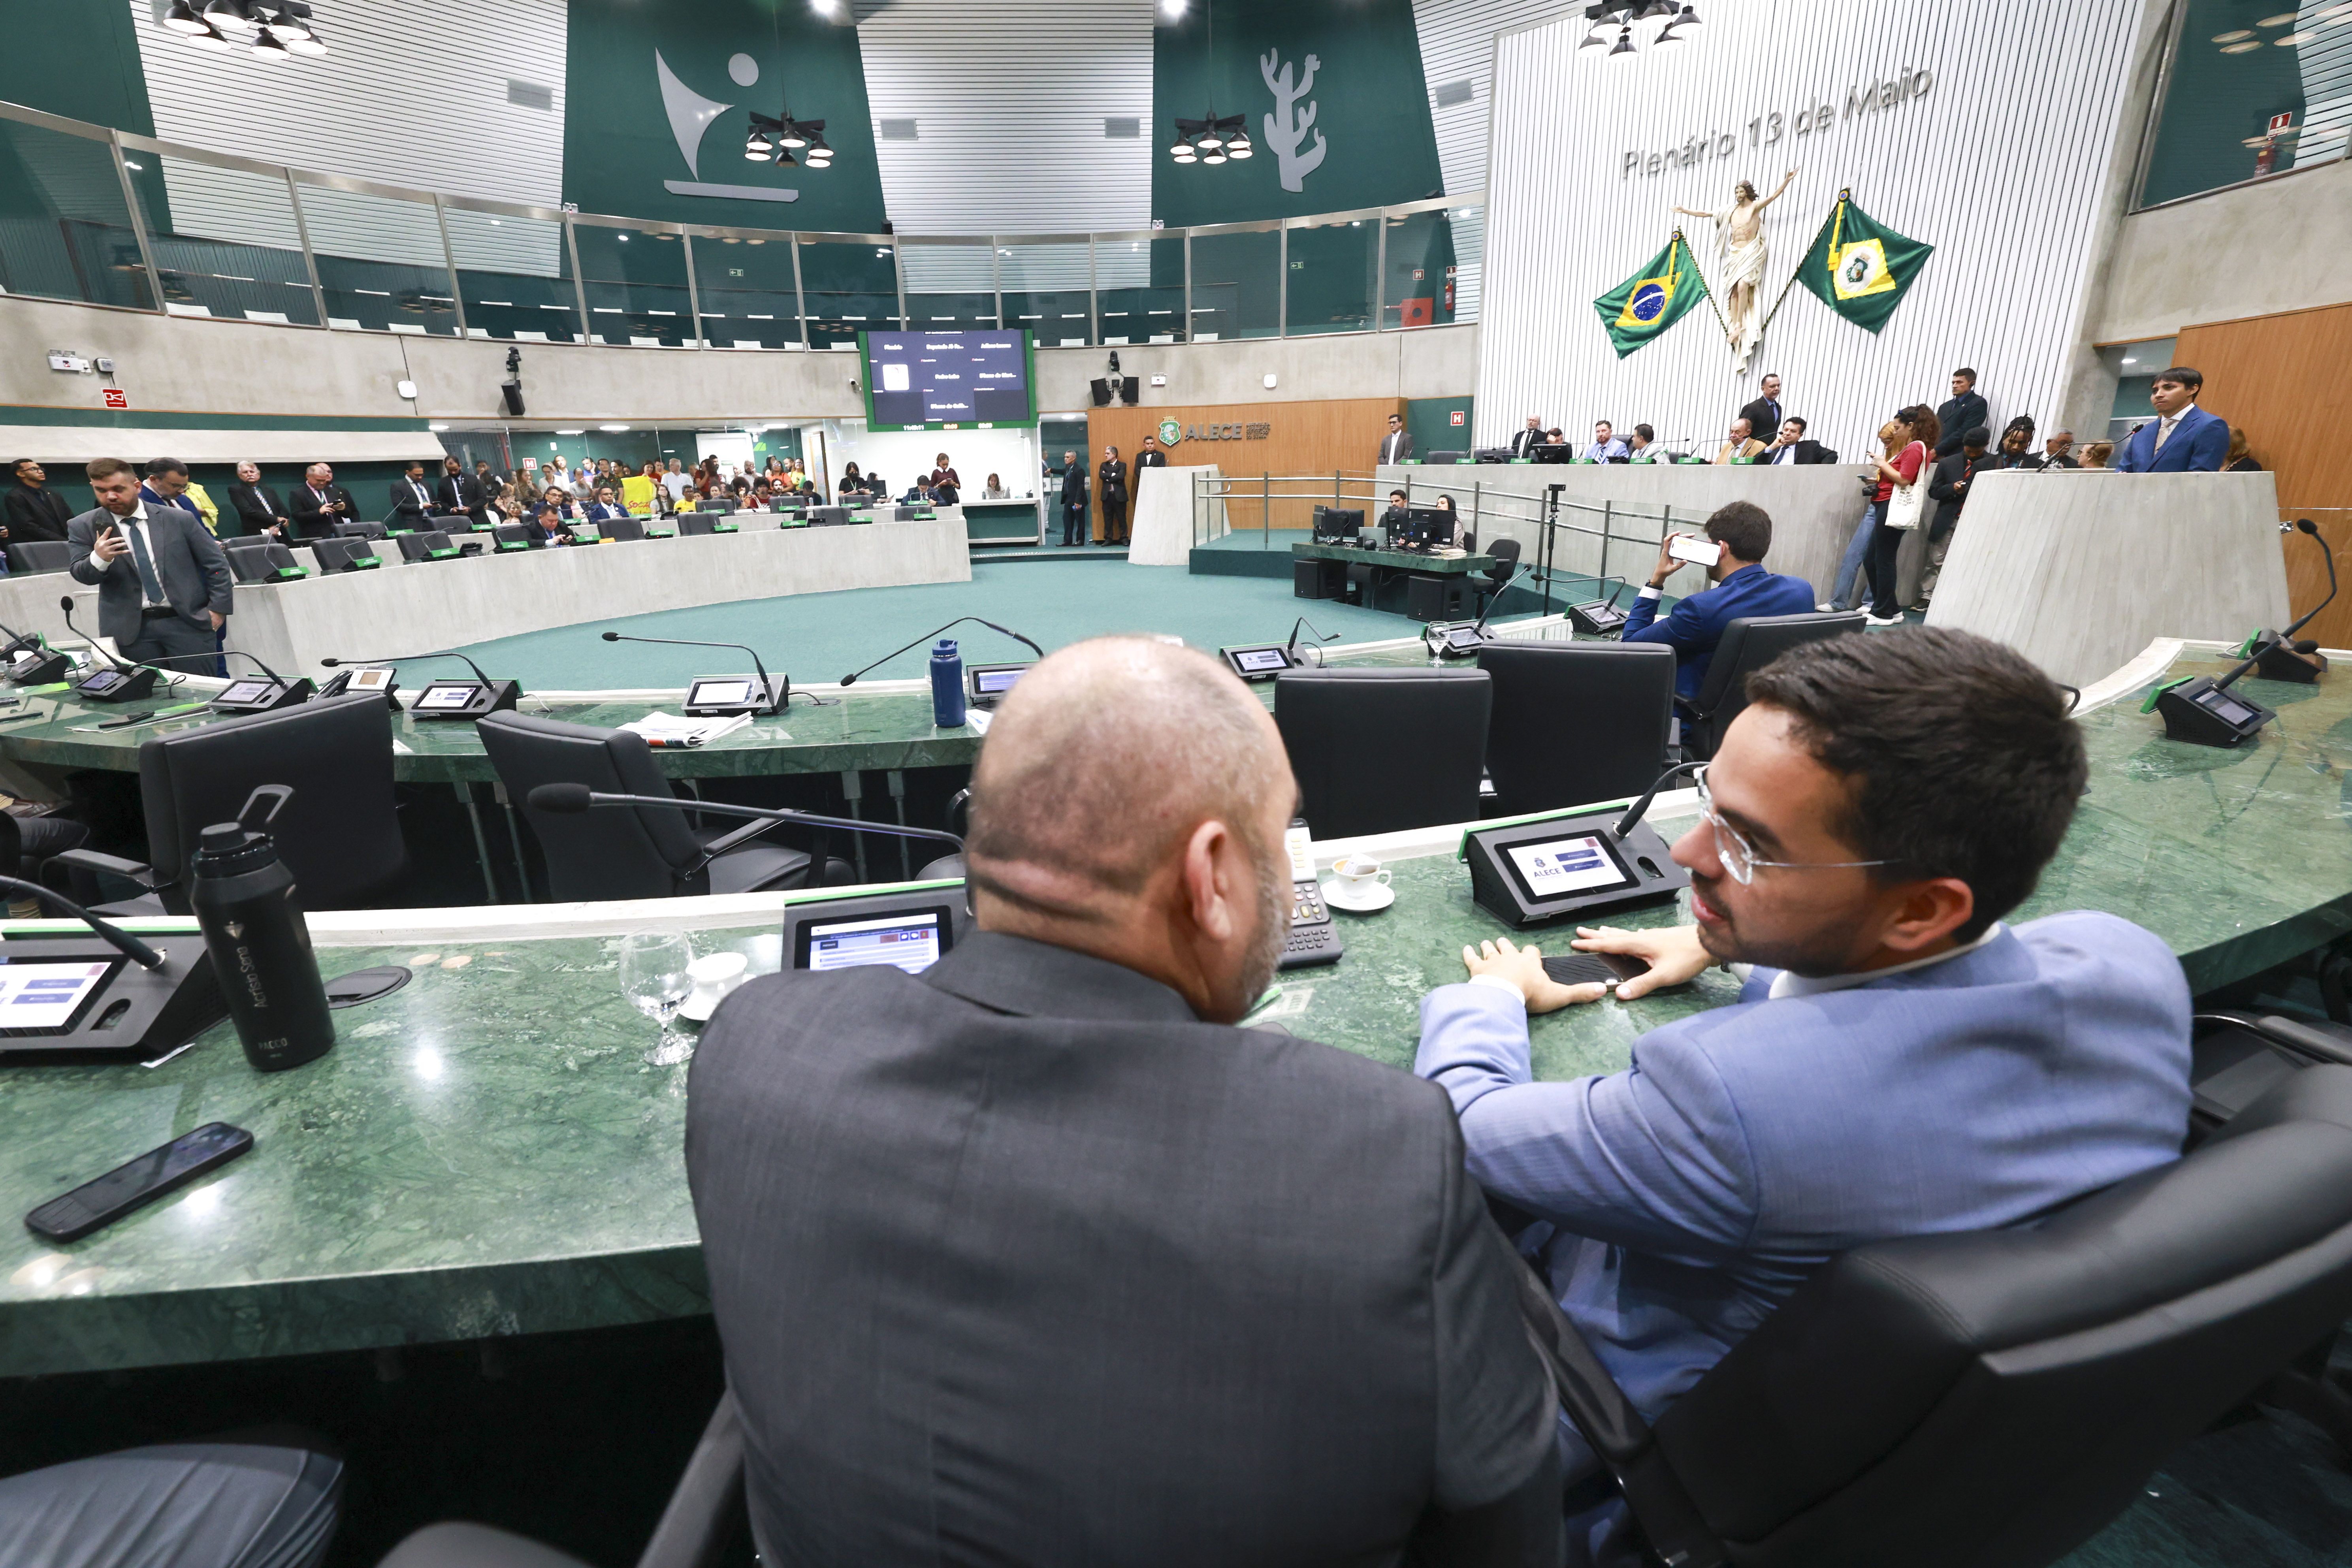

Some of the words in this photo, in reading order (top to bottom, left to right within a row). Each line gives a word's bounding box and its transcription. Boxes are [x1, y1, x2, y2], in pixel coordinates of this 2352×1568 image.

[1622, 129, 1736, 179] Plenário
[1748, 111, 1783, 147] 13
[1794, 97, 1835, 134] de
[1843, 66, 1933, 119] Maio
[1454, 414, 1461, 423] H
[1184, 423, 1242, 440] ALECE
[1534, 868, 1561, 878] ALECE
[237, 946, 255, 973] Sena
